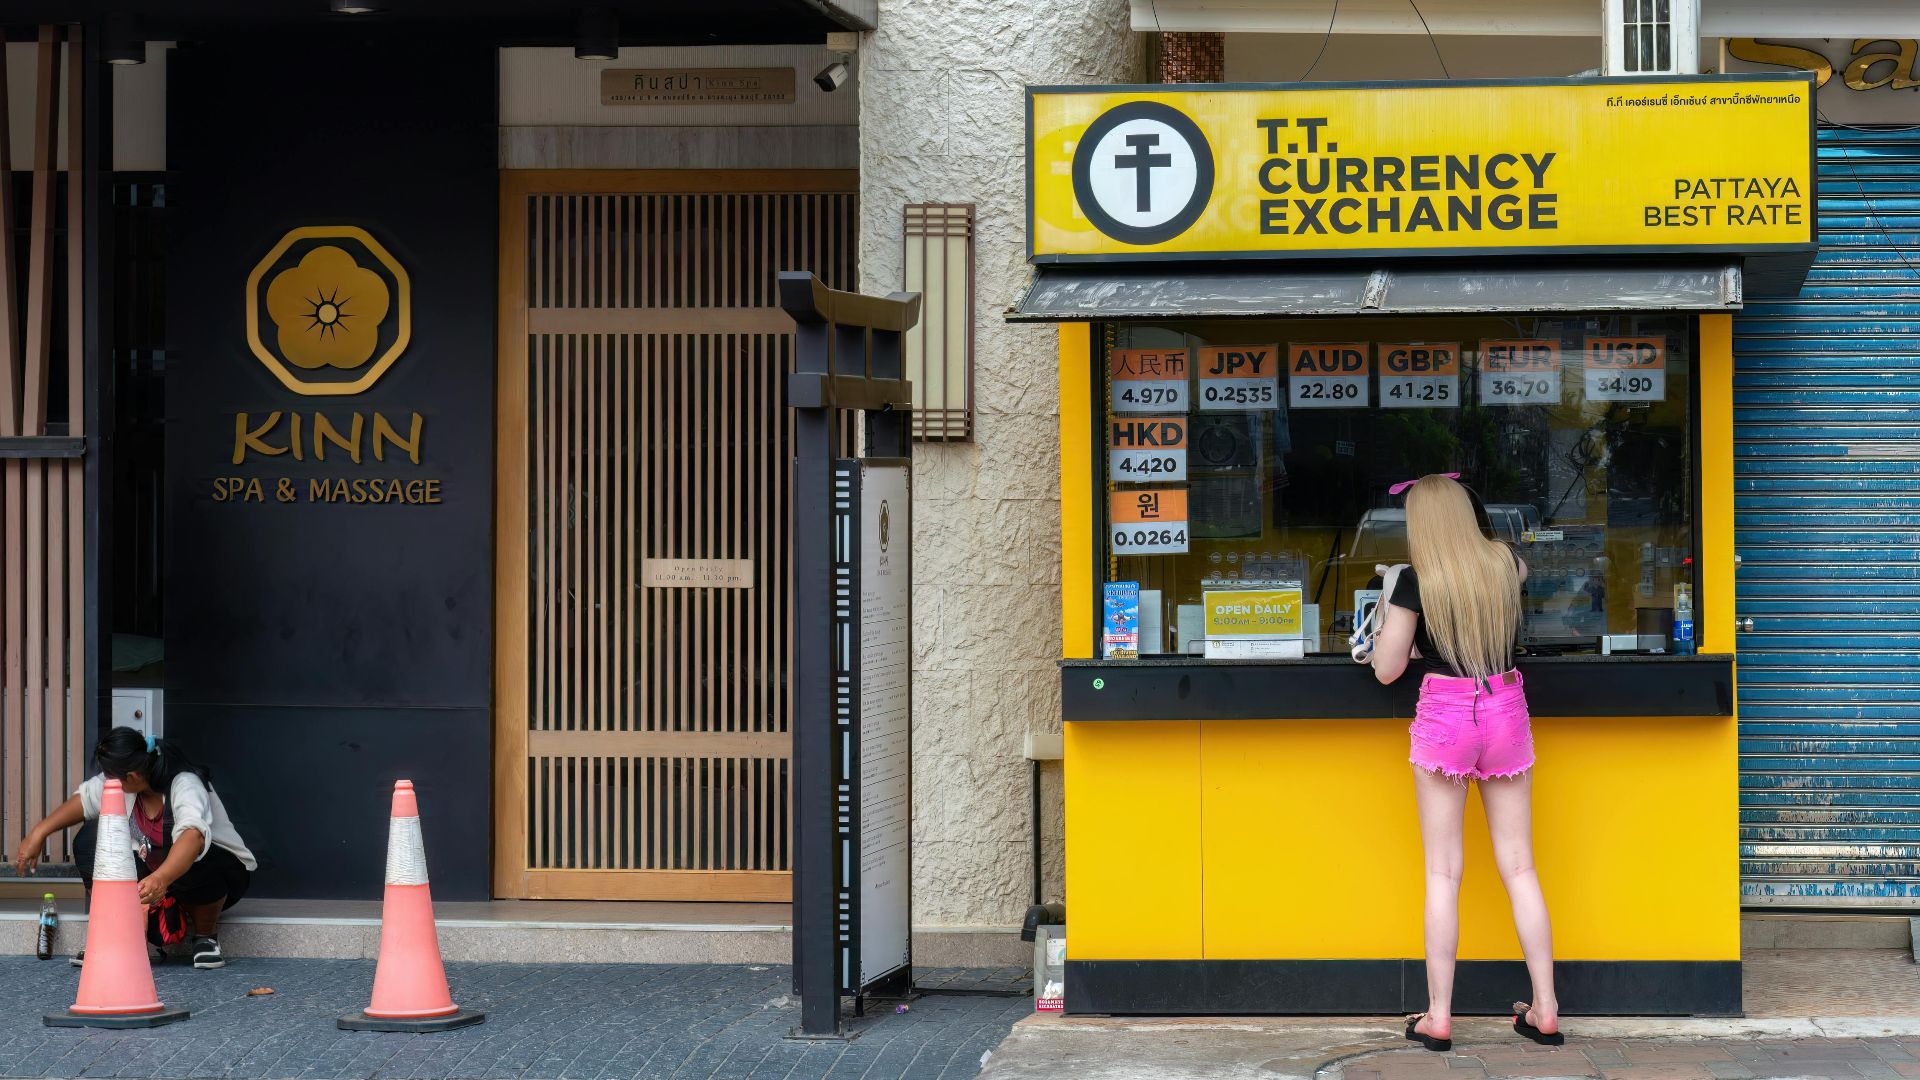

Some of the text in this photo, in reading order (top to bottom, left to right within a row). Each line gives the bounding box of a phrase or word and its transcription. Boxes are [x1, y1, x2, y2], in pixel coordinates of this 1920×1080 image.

[1256, 117, 1338, 154] T.T.
[1258, 152, 1557, 194] CURRENCY
[1674, 177, 1801, 200] PATTAYA
[1259, 193, 1558, 236] EXCHANGE
[1644, 204, 1802, 227] BEST RATE
[1113, 352, 1185, 376] 人民币
[1209, 351, 1267, 375] JPY
[1295, 350, 1363, 373] AUD
[1387, 349, 1450, 372] GBP
[1488, 345, 1552, 369] EUR
[1592, 342, 1657, 365] USD
[1121, 387, 1178, 403] 4.970
[1204, 386, 1272, 403] 0.2535
[1299, 382, 1358, 400] 22.80
[1389, 382, 1449, 401] 41.25
[1492, 379, 1549, 396] 36.70
[1597, 377, 1653, 393] 34.90
[232, 411, 423, 465] KINN
[1112, 422, 1184, 447] HKD
[1119, 456, 1177, 474] 4.420
[211, 477, 443, 505] SPA & MASSAGE
[1136, 491, 1160, 519] 원
[1113, 529, 1187, 547] 0.0264
[1215, 604, 1292, 615] OPEN DAILY
